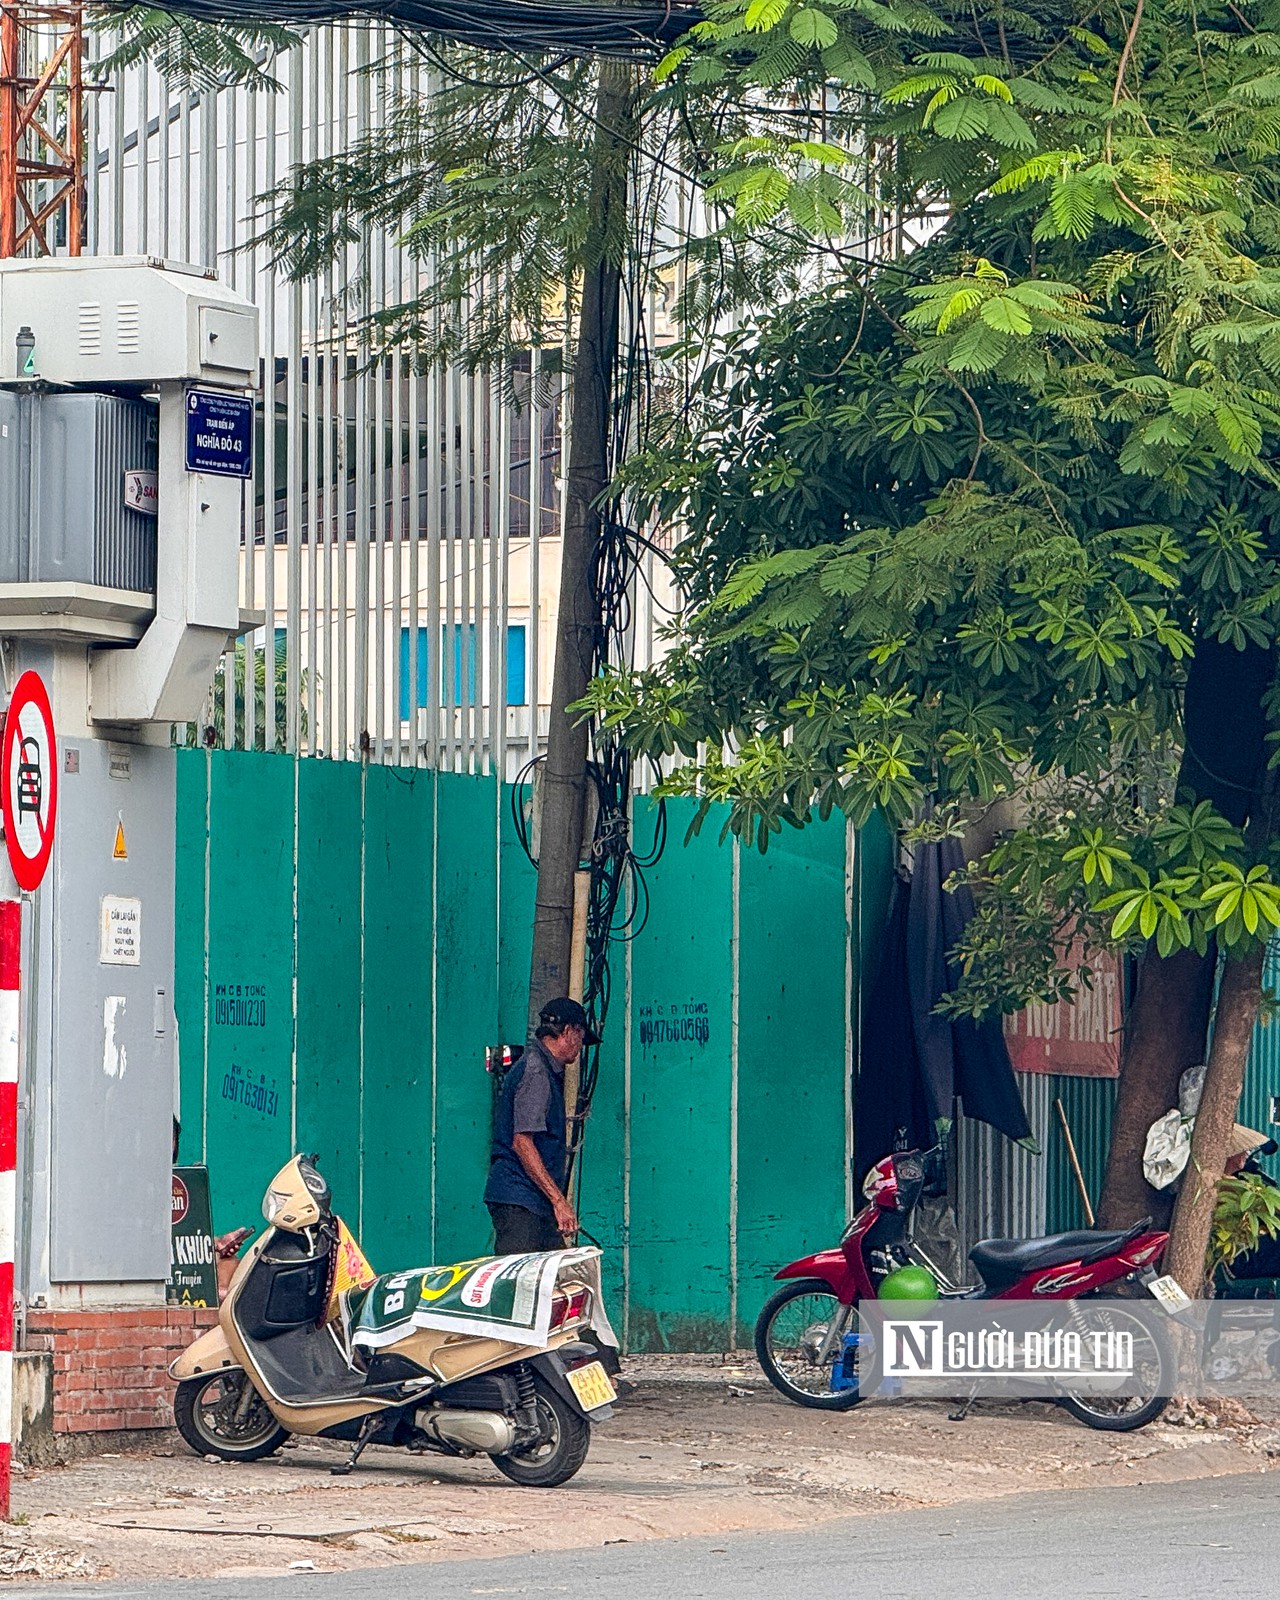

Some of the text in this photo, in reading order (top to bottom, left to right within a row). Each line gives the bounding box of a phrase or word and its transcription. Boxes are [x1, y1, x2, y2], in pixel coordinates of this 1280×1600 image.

[197, 433, 221, 450] NGHĨA
[233, 440, 242, 453] 43
[216, 998, 266, 1027] 0915011230
[175, 1229, 213, 1265] KHÚC
